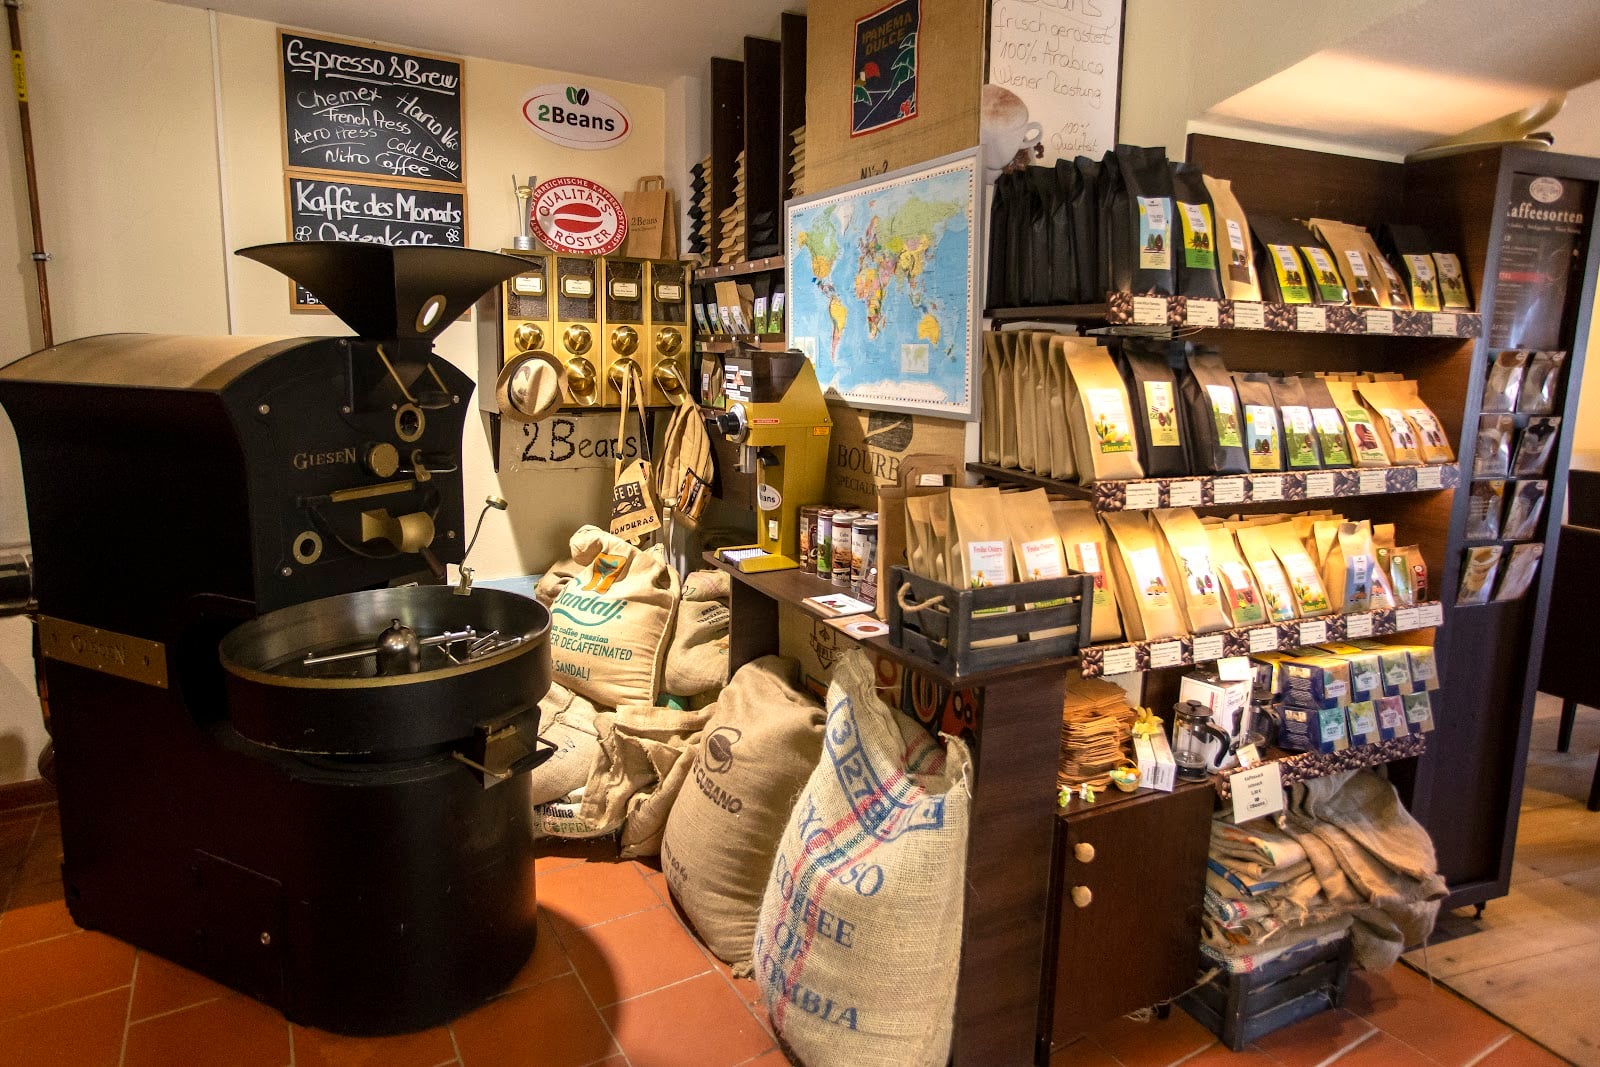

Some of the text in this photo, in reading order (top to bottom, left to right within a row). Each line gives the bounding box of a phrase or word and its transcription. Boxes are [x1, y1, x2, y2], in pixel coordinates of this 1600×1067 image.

[862, 12, 913, 44] IPANEMA
[865, 29, 906, 56] DULCE
[1000, 40, 1037, 65] 100%
[287, 39, 385, 80] Espresso
[402, 60, 459, 90] Brew
[296, 86, 383, 108] Chemex
[396, 92, 442, 137] Hario
[323, 107, 412, 136] French Press
[537, 104, 616, 132] 2Beans
[294, 127, 331, 146] Aero
[325, 147, 432, 178] Nitro Coffee
[386, 137, 460, 172] Cold Brew
[296, 181, 461, 224] Kaffee des Monats
[554, 229, 612, 247] RÖSTER
[293, 447, 357, 470] GIESEN
[627, 483, 640, 498] DE
[559, 627, 579, 638] coffee
[561, 637, 633, 661] DECAFFEINATED
